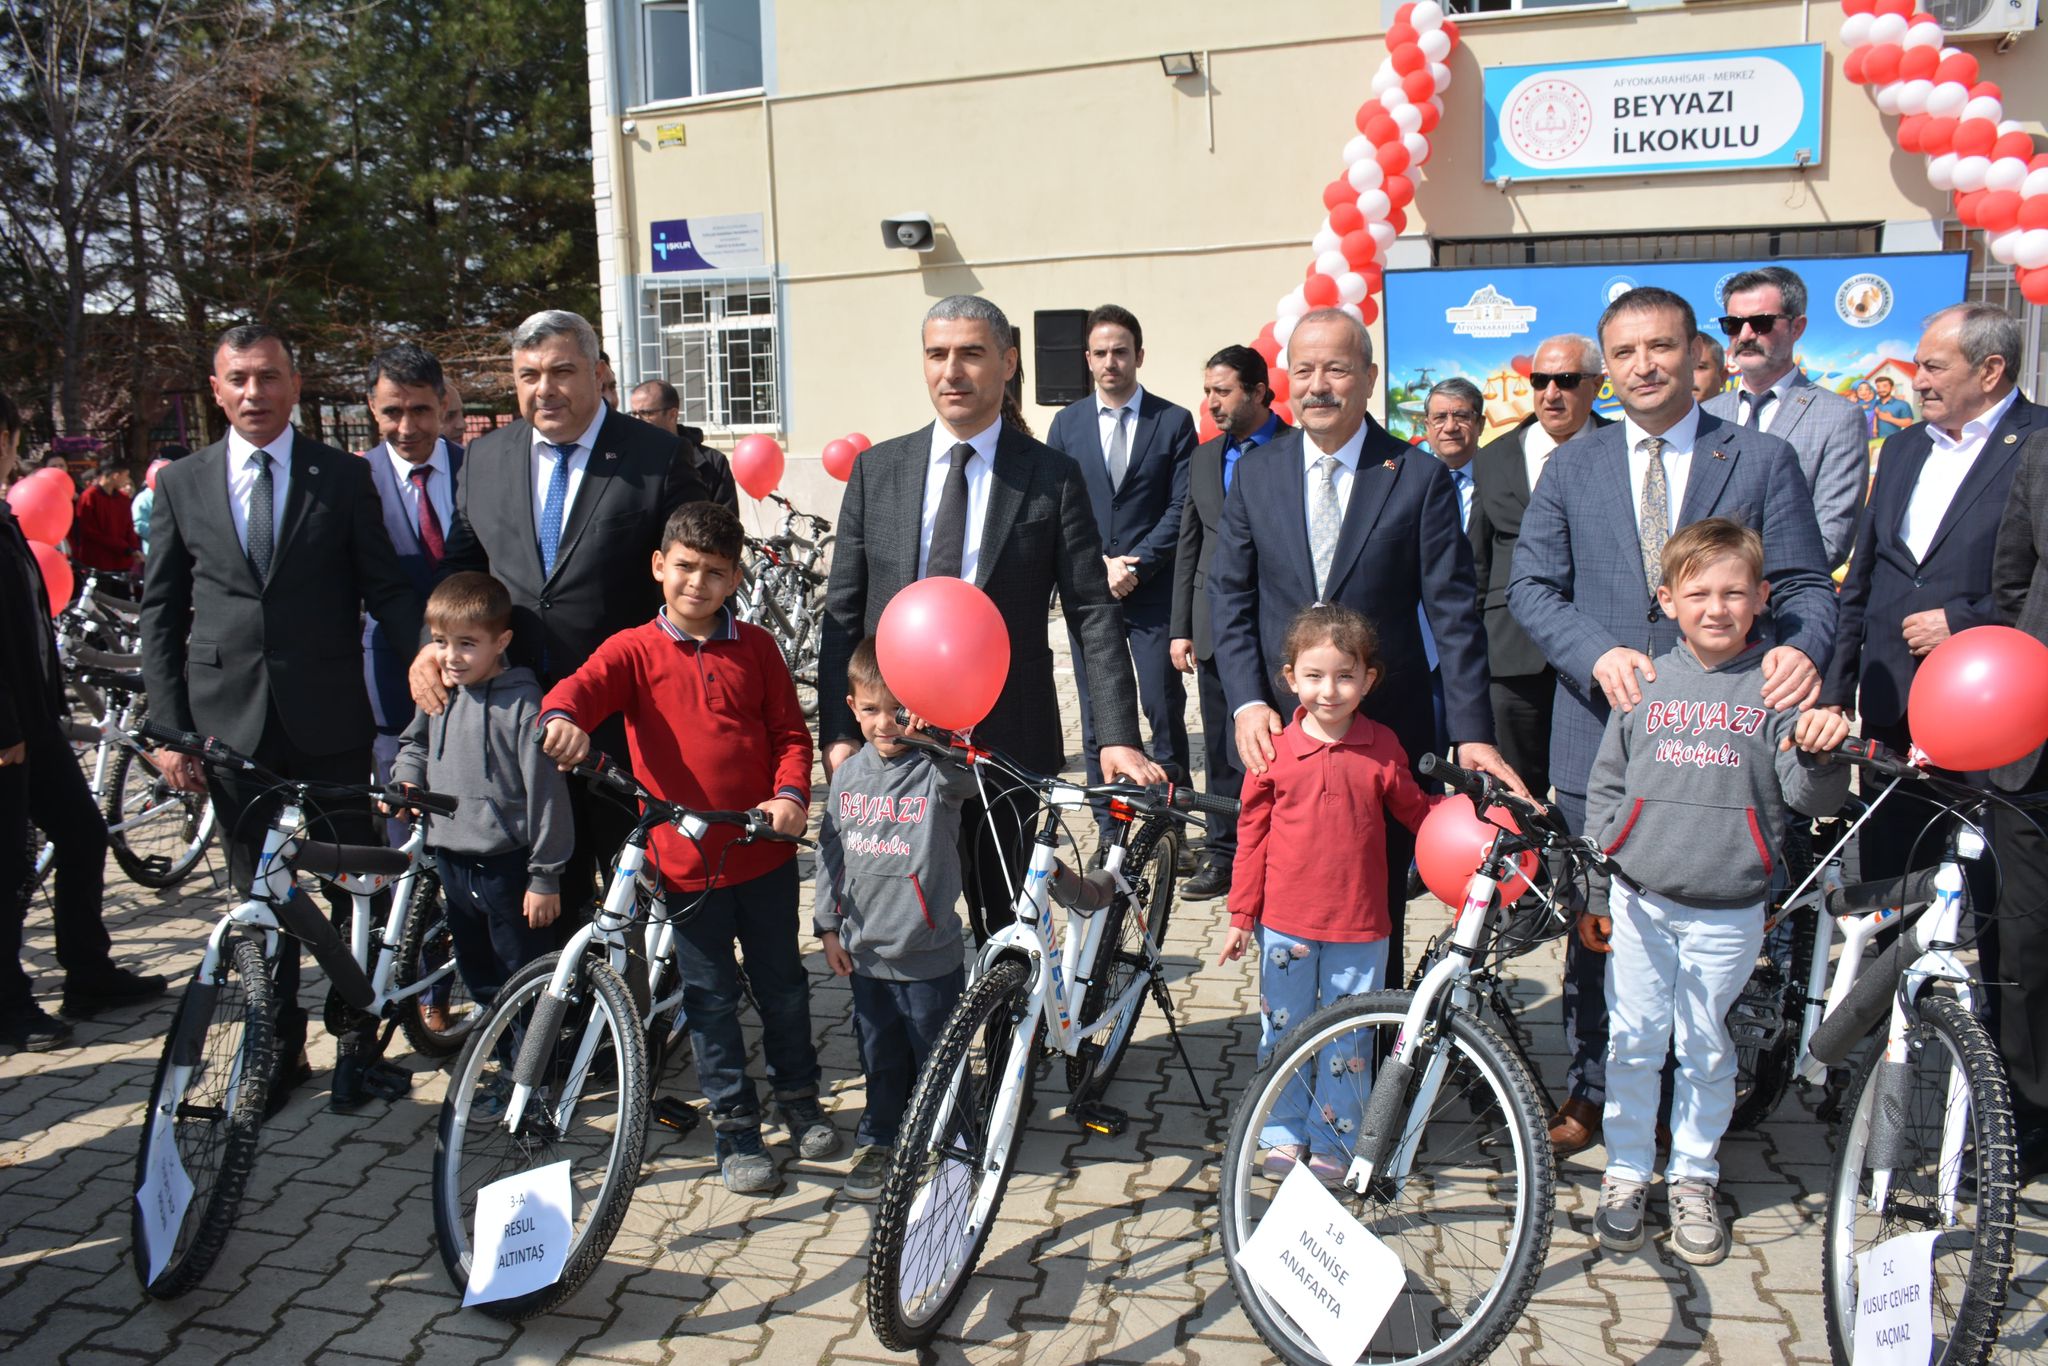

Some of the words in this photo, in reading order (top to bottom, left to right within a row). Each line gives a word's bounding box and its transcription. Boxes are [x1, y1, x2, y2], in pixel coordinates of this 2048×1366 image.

[1713, 69, 1755, 81] MERKEZ
[1613, 90, 1733, 119] BEYYAZI
[1613, 125, 1760, 154] İLKOKULU
[510, 1193, 526, 1208] 3-A
[504, 1217, 536, 1239] RESUL
[1325, 1223, 1345, 1245] 1-B
[497, 1244, 545, 1269] ALTINTAŞ
[1299, 1230, 1350, 1286] MUNİSE
[1883, 1260, 1895, 1276] 2-C
[1279, 1249, 1342, 1319] ANAFARTA
[1863, 1294, 1888, 1316] YUSUF
[1889, 1284, 1921, 1308] CEVHER
[1875, 1323, 1911, 1350] KAÇMAZ
